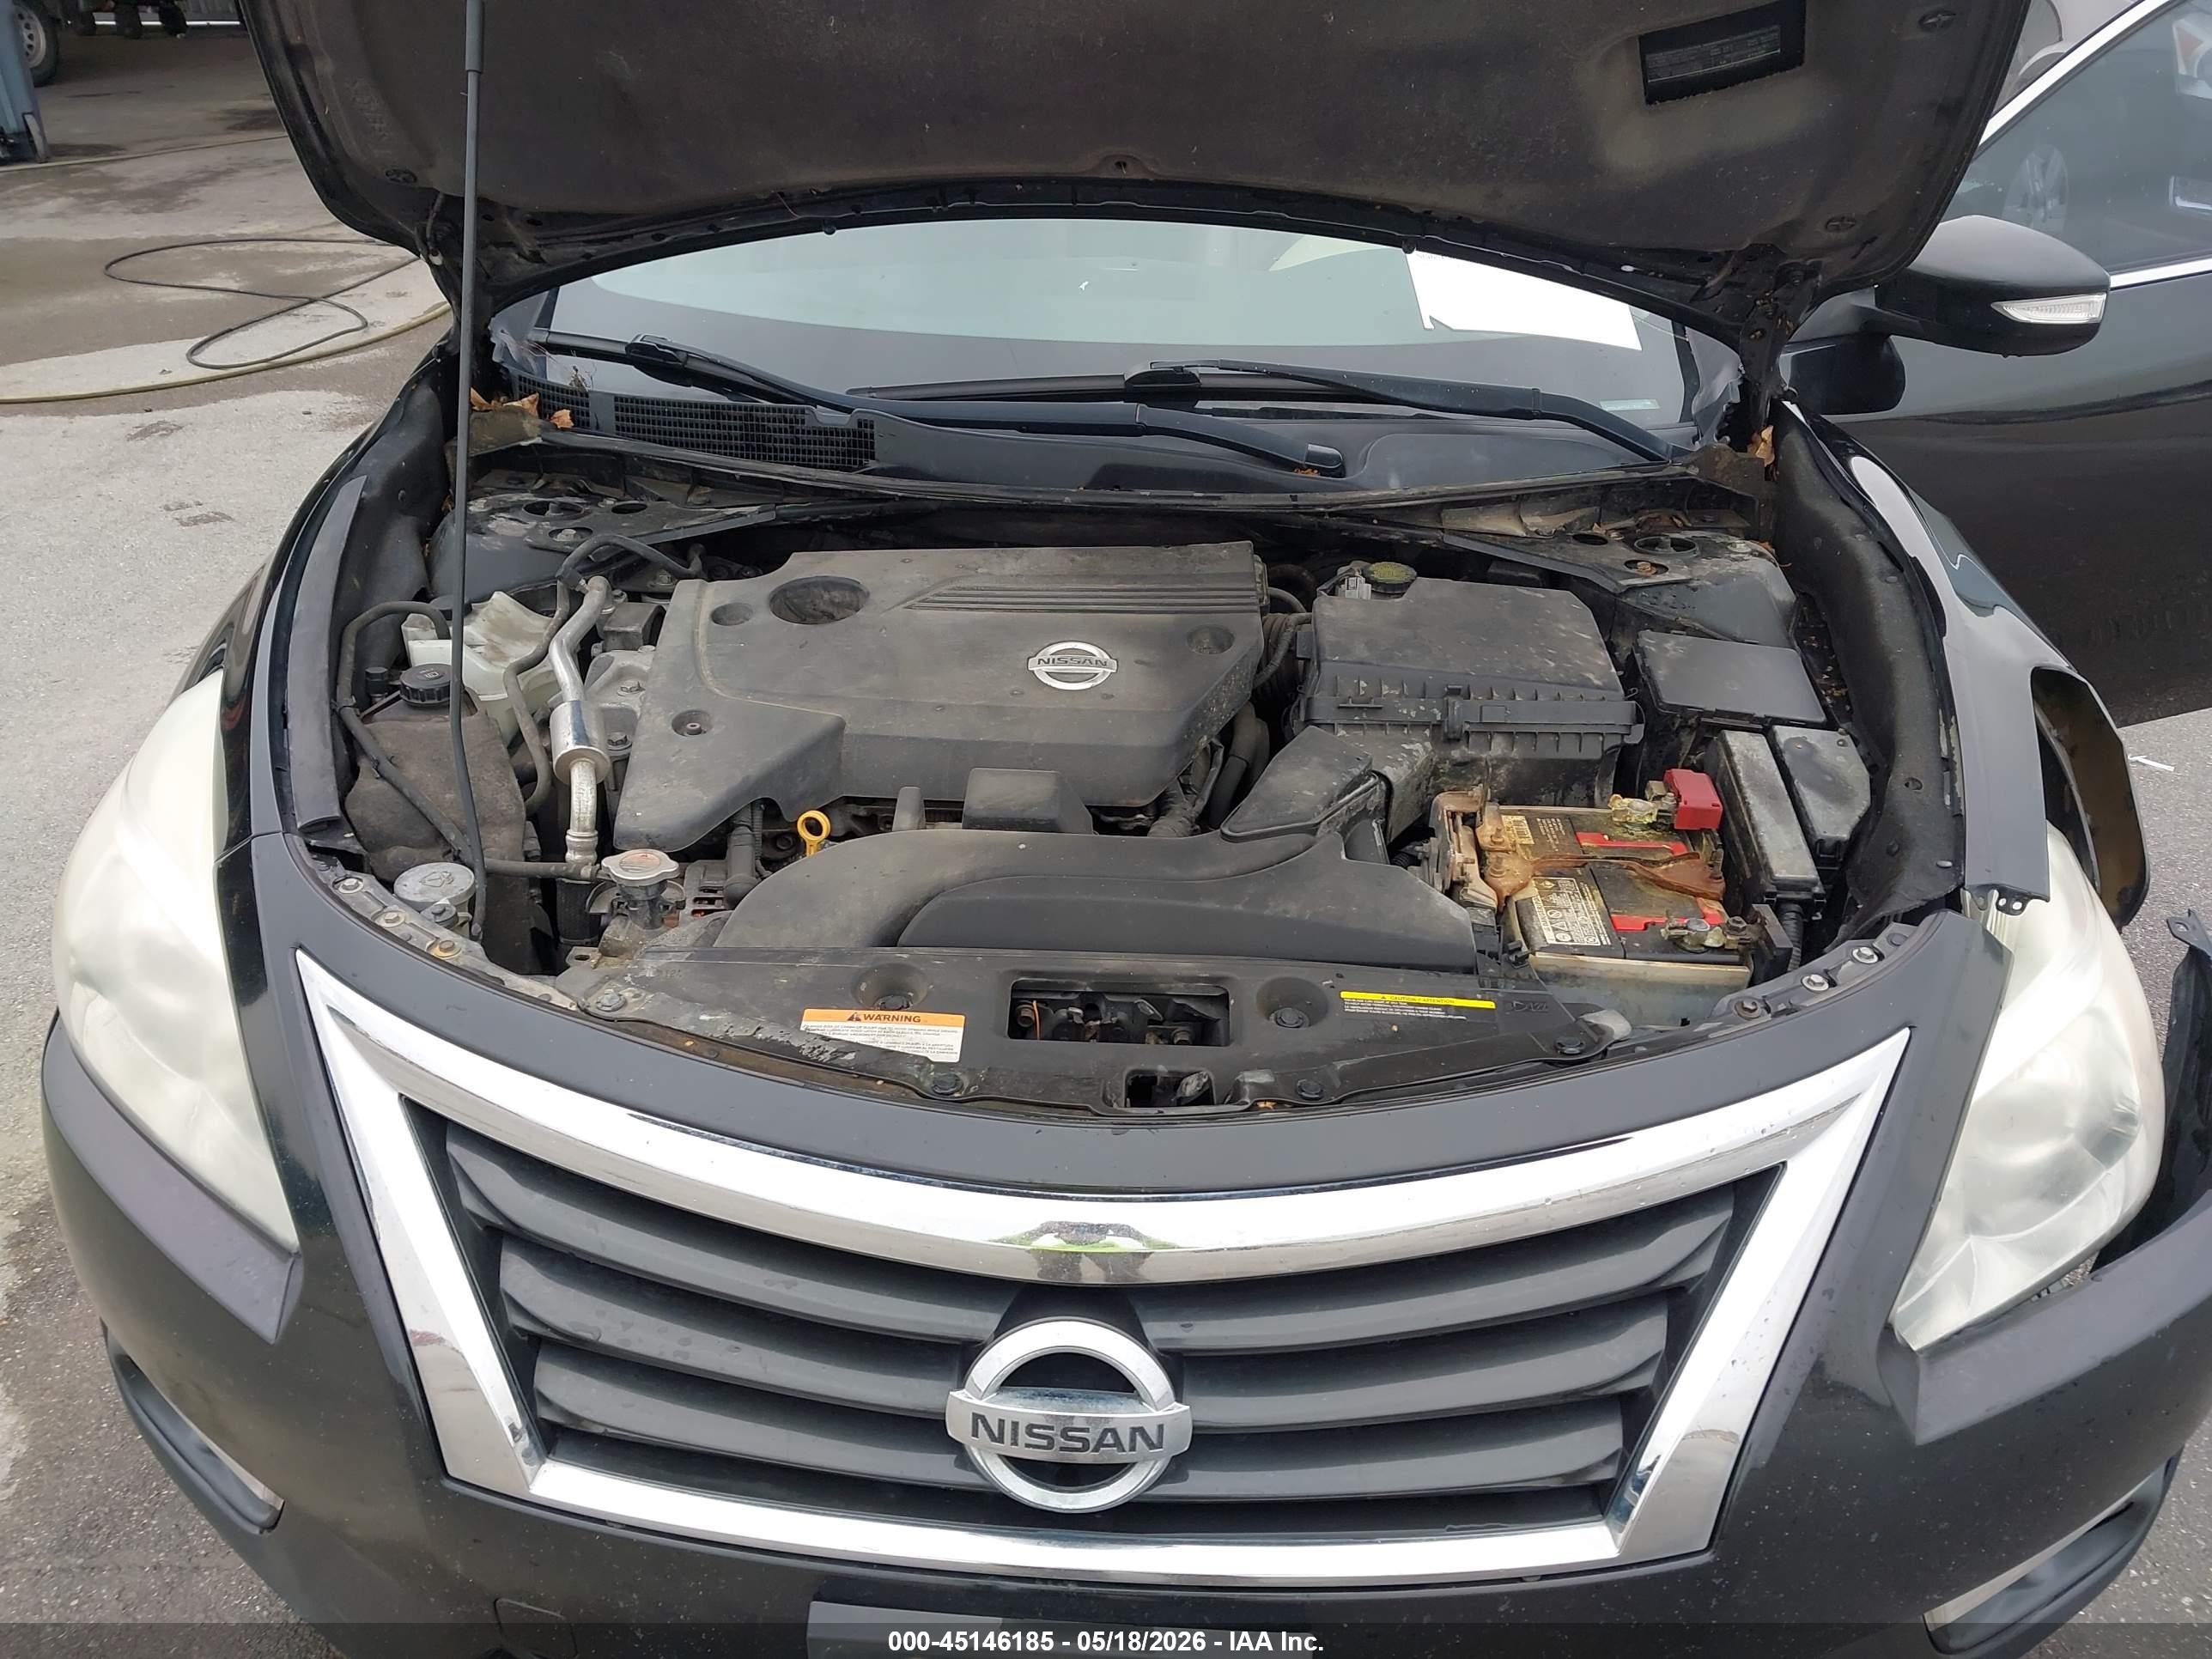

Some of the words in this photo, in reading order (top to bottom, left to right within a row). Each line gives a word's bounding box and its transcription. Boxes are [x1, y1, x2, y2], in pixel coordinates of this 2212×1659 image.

[1036, 657, 1108, 667] NISSAN
[863, 1013, 921, 1023] WARNING
[970, 1411, 1165, 1455] NISSAN
